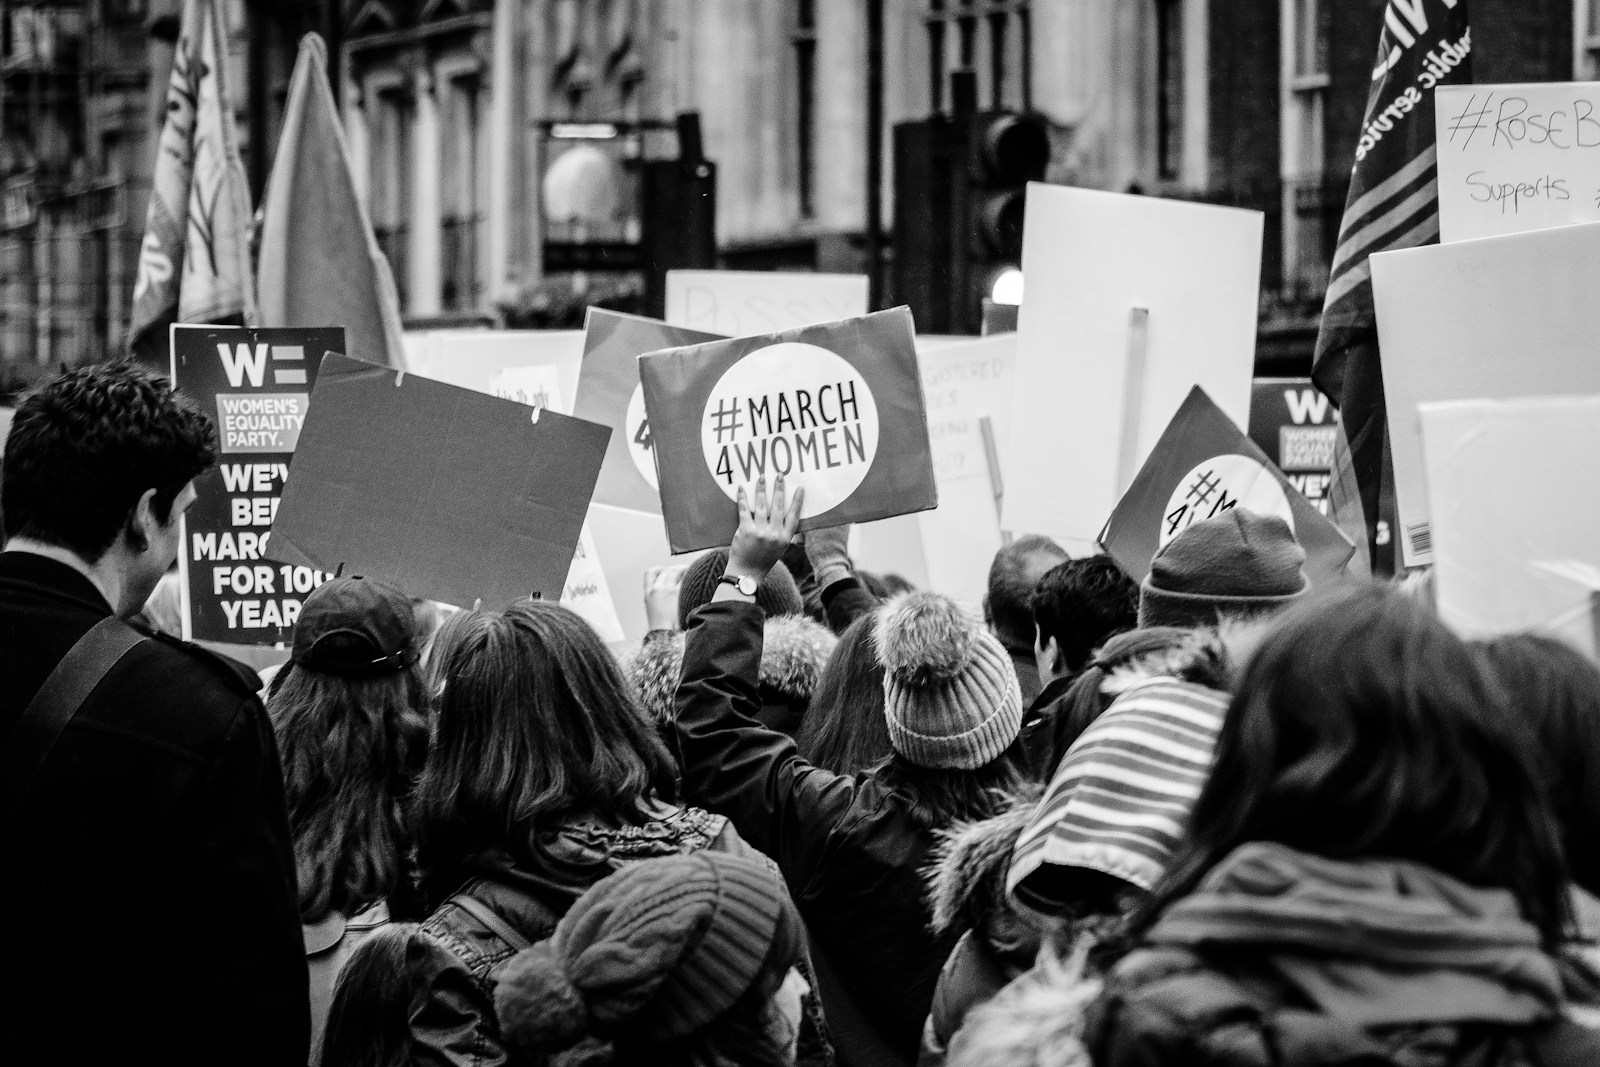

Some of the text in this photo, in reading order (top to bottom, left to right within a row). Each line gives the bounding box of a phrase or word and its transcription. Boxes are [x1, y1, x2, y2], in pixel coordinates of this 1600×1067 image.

[1466, 171, 1570, 214] Supports
[223, 398, 299, 415] WOMEN'S
[710, 379, 859, 444] #MARCH
[226, 430, 283, 447] PARTY.
[716, 422, 866, 485] 4WOMEN
[213, 565, 276, 595] FOR
